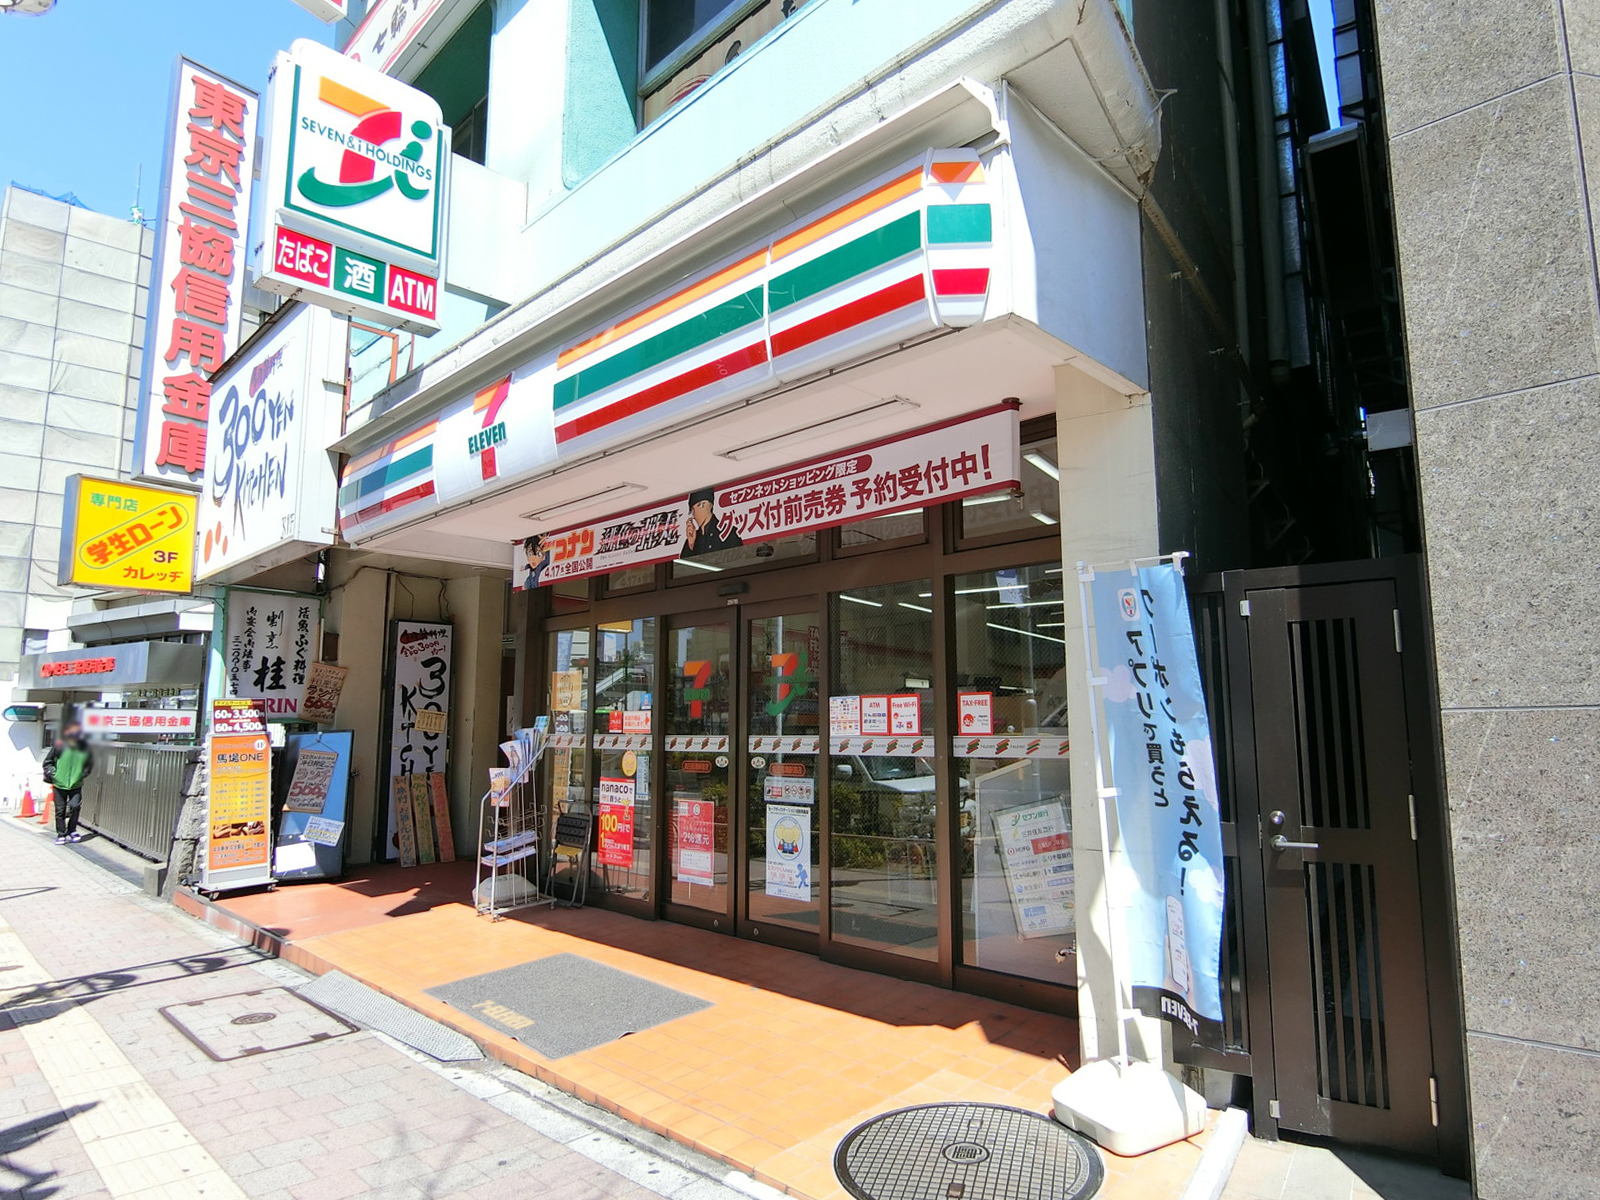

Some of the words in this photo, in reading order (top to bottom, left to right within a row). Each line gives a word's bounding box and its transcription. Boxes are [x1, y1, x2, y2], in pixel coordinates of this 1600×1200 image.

[366, 144, 432, 181] HOLDINGS
[155, 74, 247, 474] 東京三協信用金庫
[277, 236, 329, 279] たばこ
[344, 257, 377, 294] 酒
[391, 274, 433, 312] ATM
[729, 458, 858, 503] セブンネットショッピング限定
[90, 492, 139, 512] 専門店
[717, 487, 847, 541] グッズ付前売券
[86, 506, 183, 565] 学生ローン
[553, 528, 596, 562] コナン
[153, 550, 178, 564] 3F
[292, 606, 311, 685] 活魚ふぐ料理
[253, 655, 287, 693] 桂
[267, 698, 298, 713] RIN
[962, 699, 988, 707] TAX-FREE
[217, 752, 264, 763] 馬場ONE
[1022, 809, 1049, 822] セブン銀行
